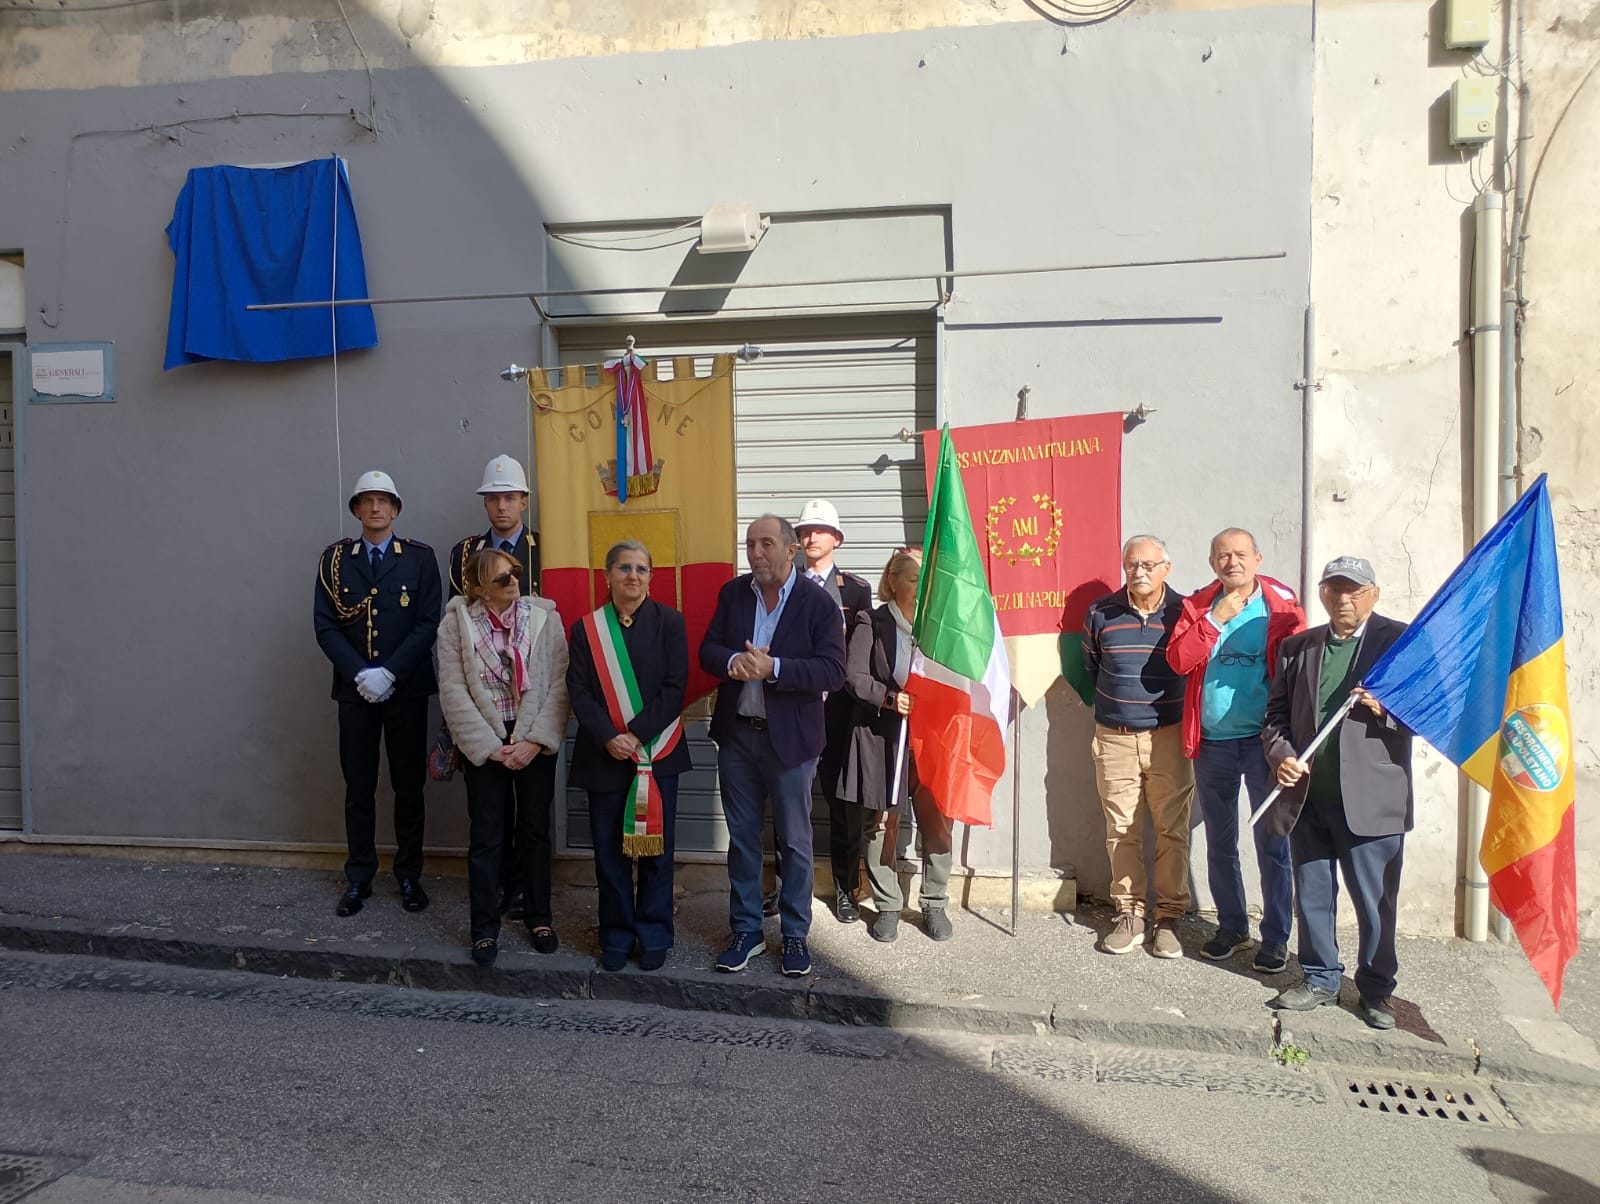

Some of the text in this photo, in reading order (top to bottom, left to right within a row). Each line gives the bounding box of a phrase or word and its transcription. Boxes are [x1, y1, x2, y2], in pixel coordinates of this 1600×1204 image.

[568, 399, 695, 443] CONE
[1012, 515, 1038, 538] AMI
[1023, 589, 1066, 609] NAPOLI
[1508, 731, 1552, 787] NAPOLETANO
[1512, 719, 1559, 783] RISORGIMENTO
